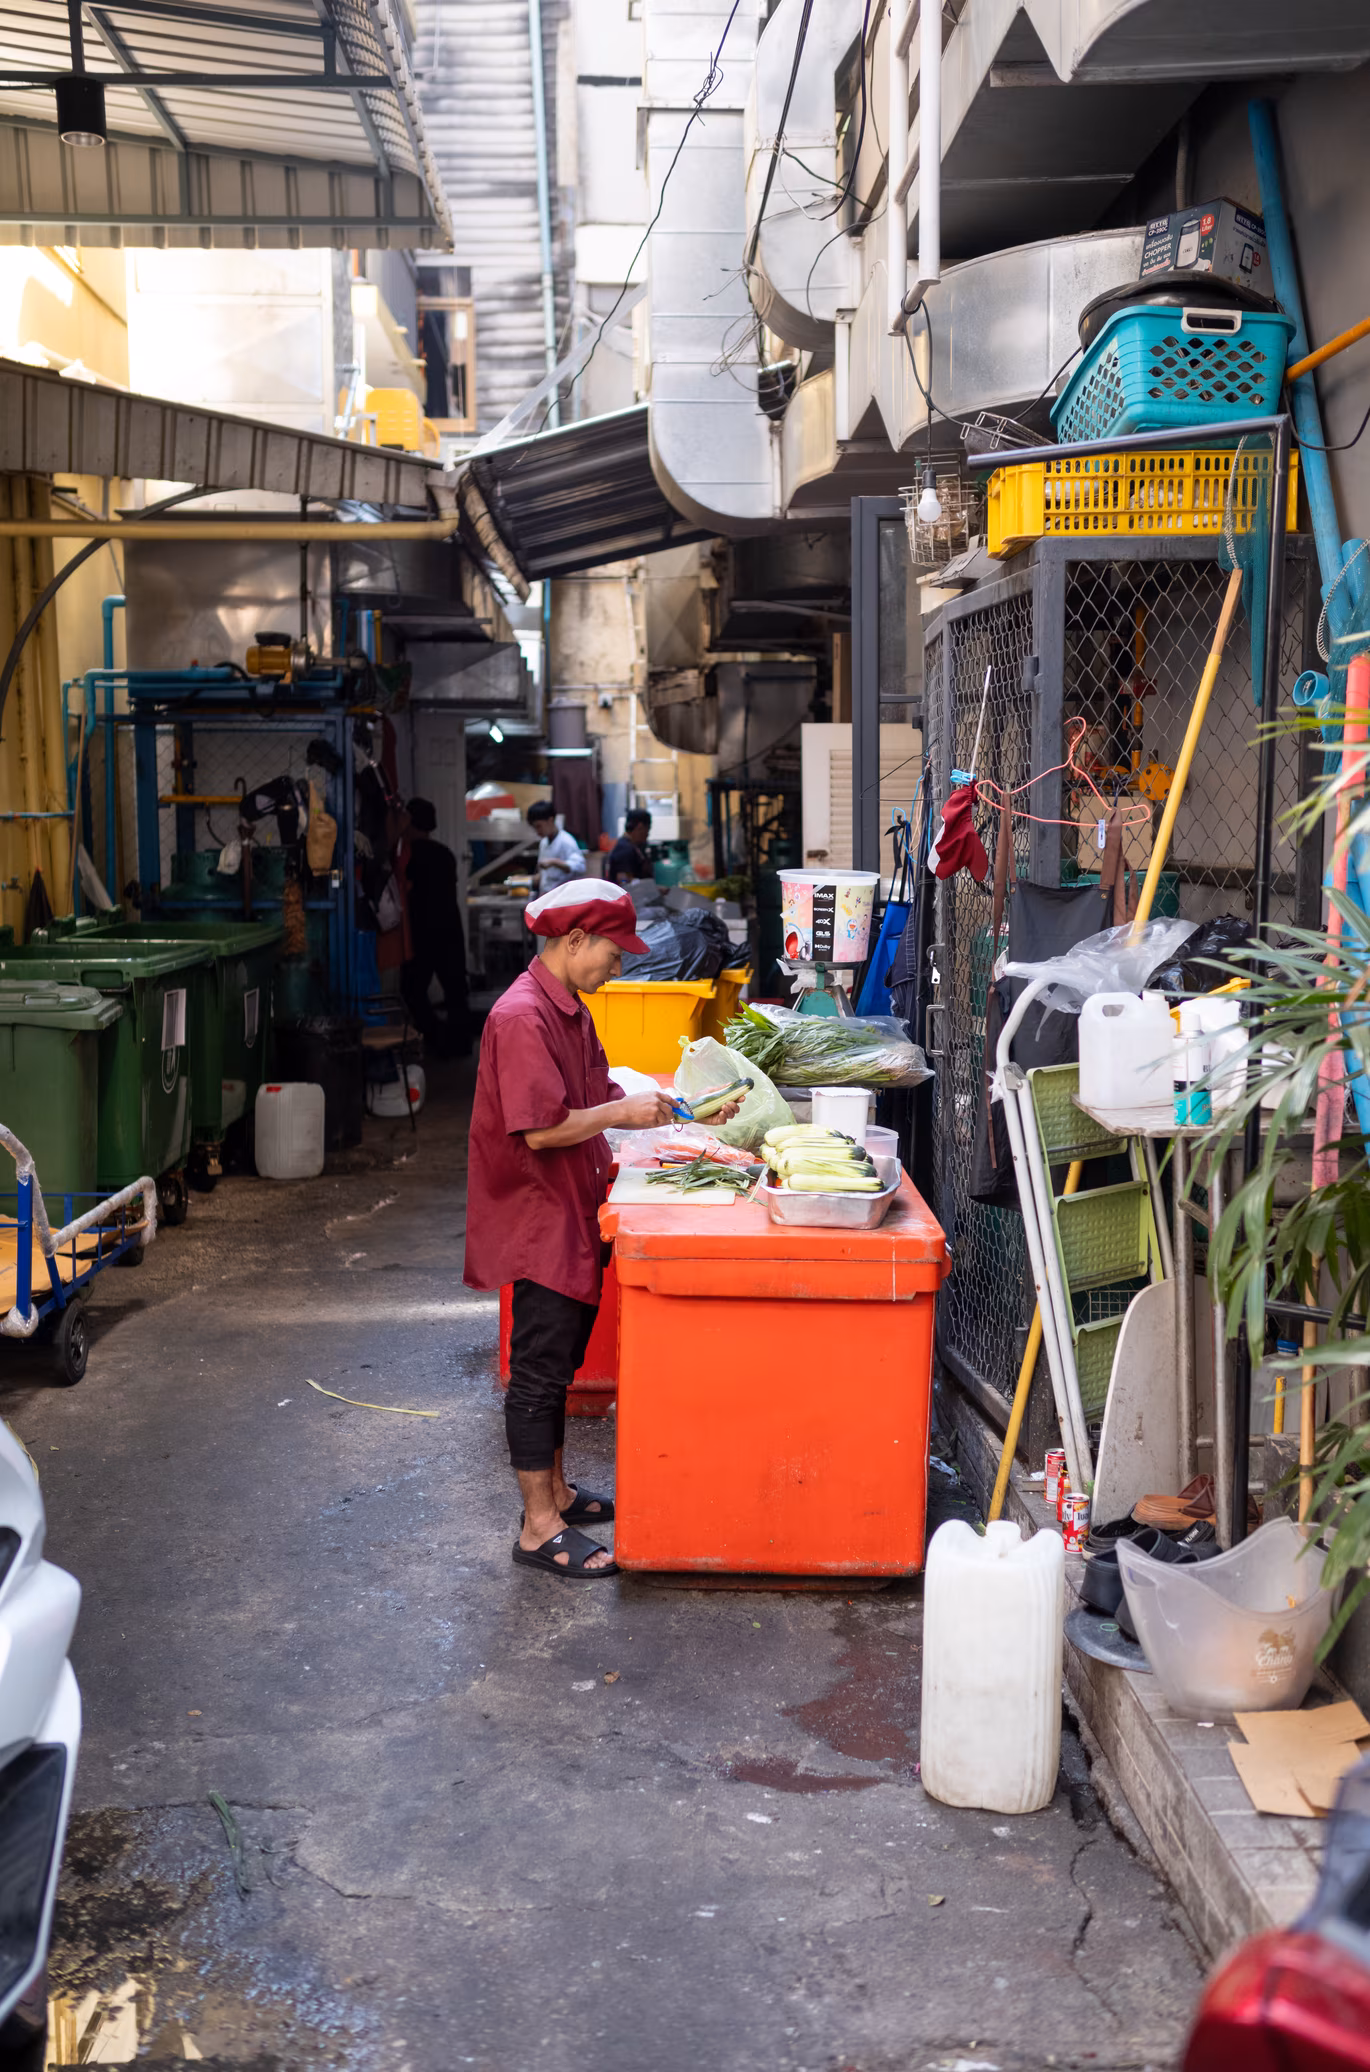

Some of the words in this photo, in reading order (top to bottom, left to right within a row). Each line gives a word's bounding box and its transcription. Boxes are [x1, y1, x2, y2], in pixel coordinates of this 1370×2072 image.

[1203, 216, 1211, 225] 1.8
[1144, 242, 1171, 259] CHOPPER
[815, 918, 831, 926] 4DX
